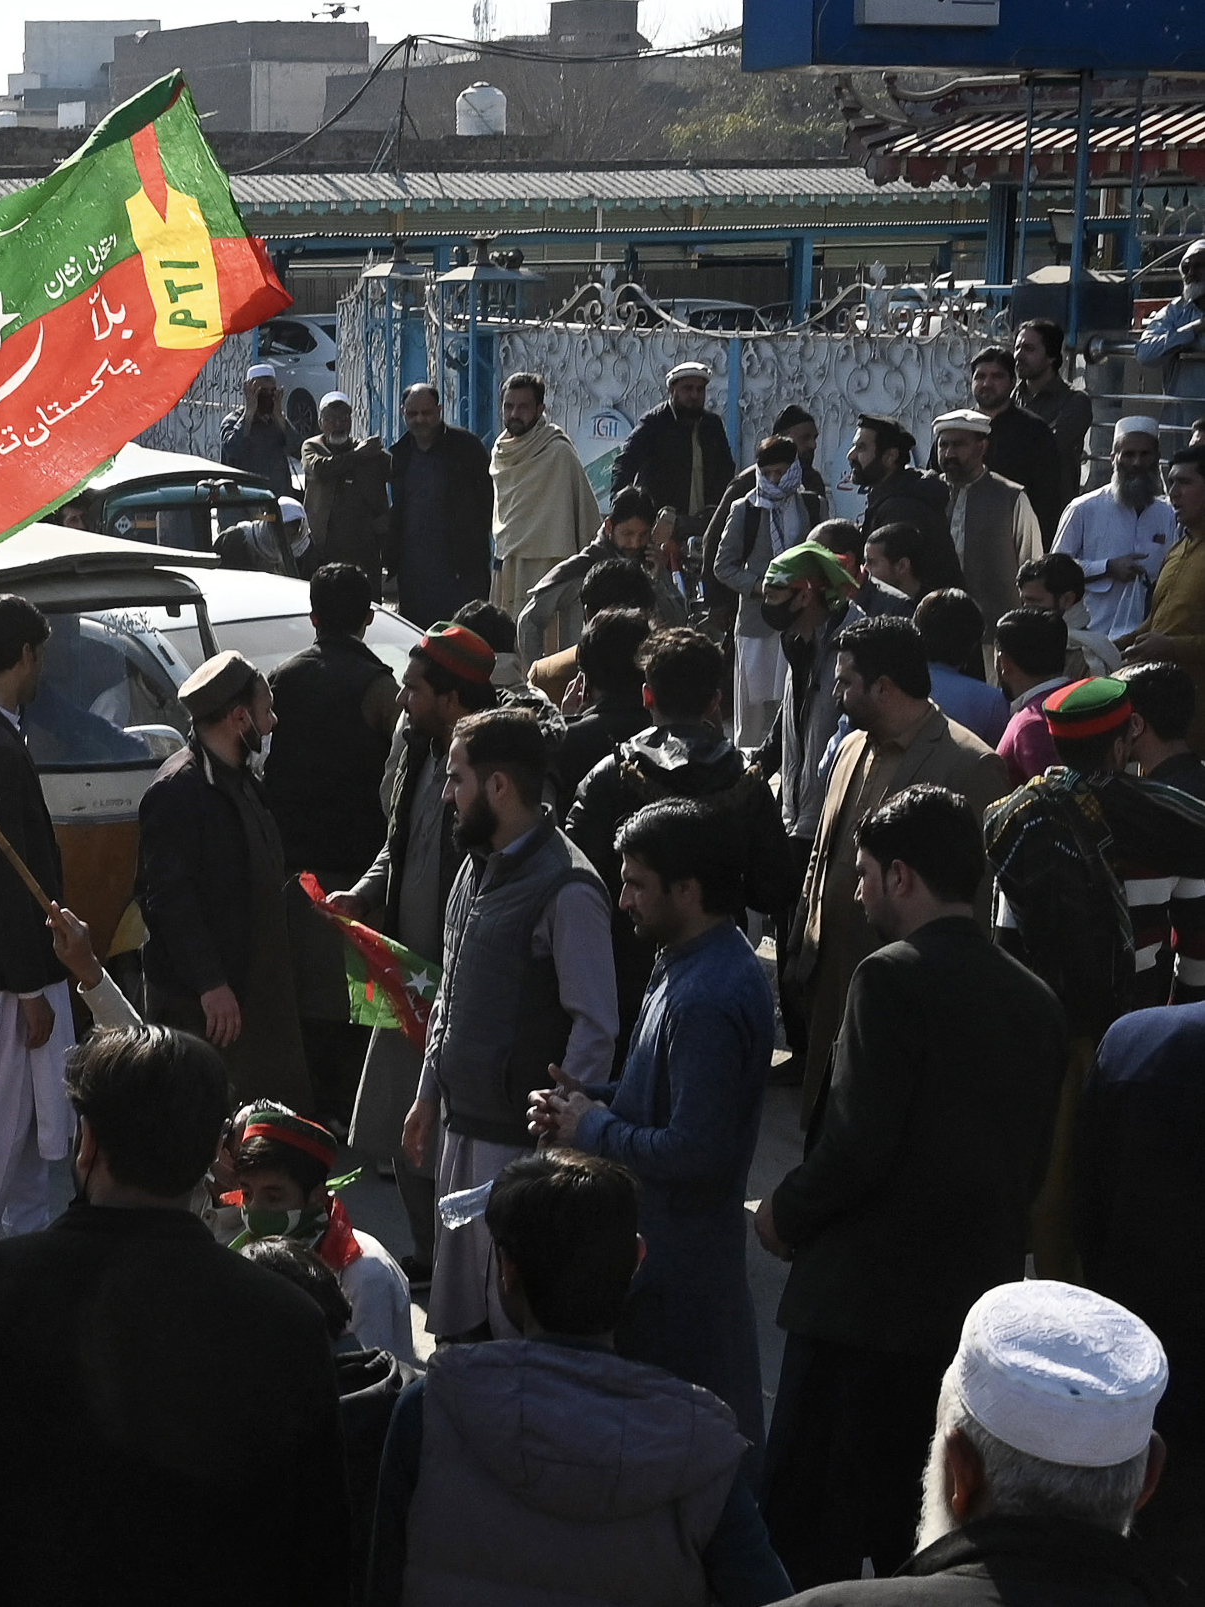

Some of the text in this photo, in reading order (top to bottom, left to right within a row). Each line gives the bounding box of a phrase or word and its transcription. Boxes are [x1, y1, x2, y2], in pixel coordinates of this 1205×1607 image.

[44, 256, 83, 299] نشان
[160, 260, 208, 330] PTI
[23, 358, 141, 447] پاکستان
[593, 417, 618, 437] IGH
